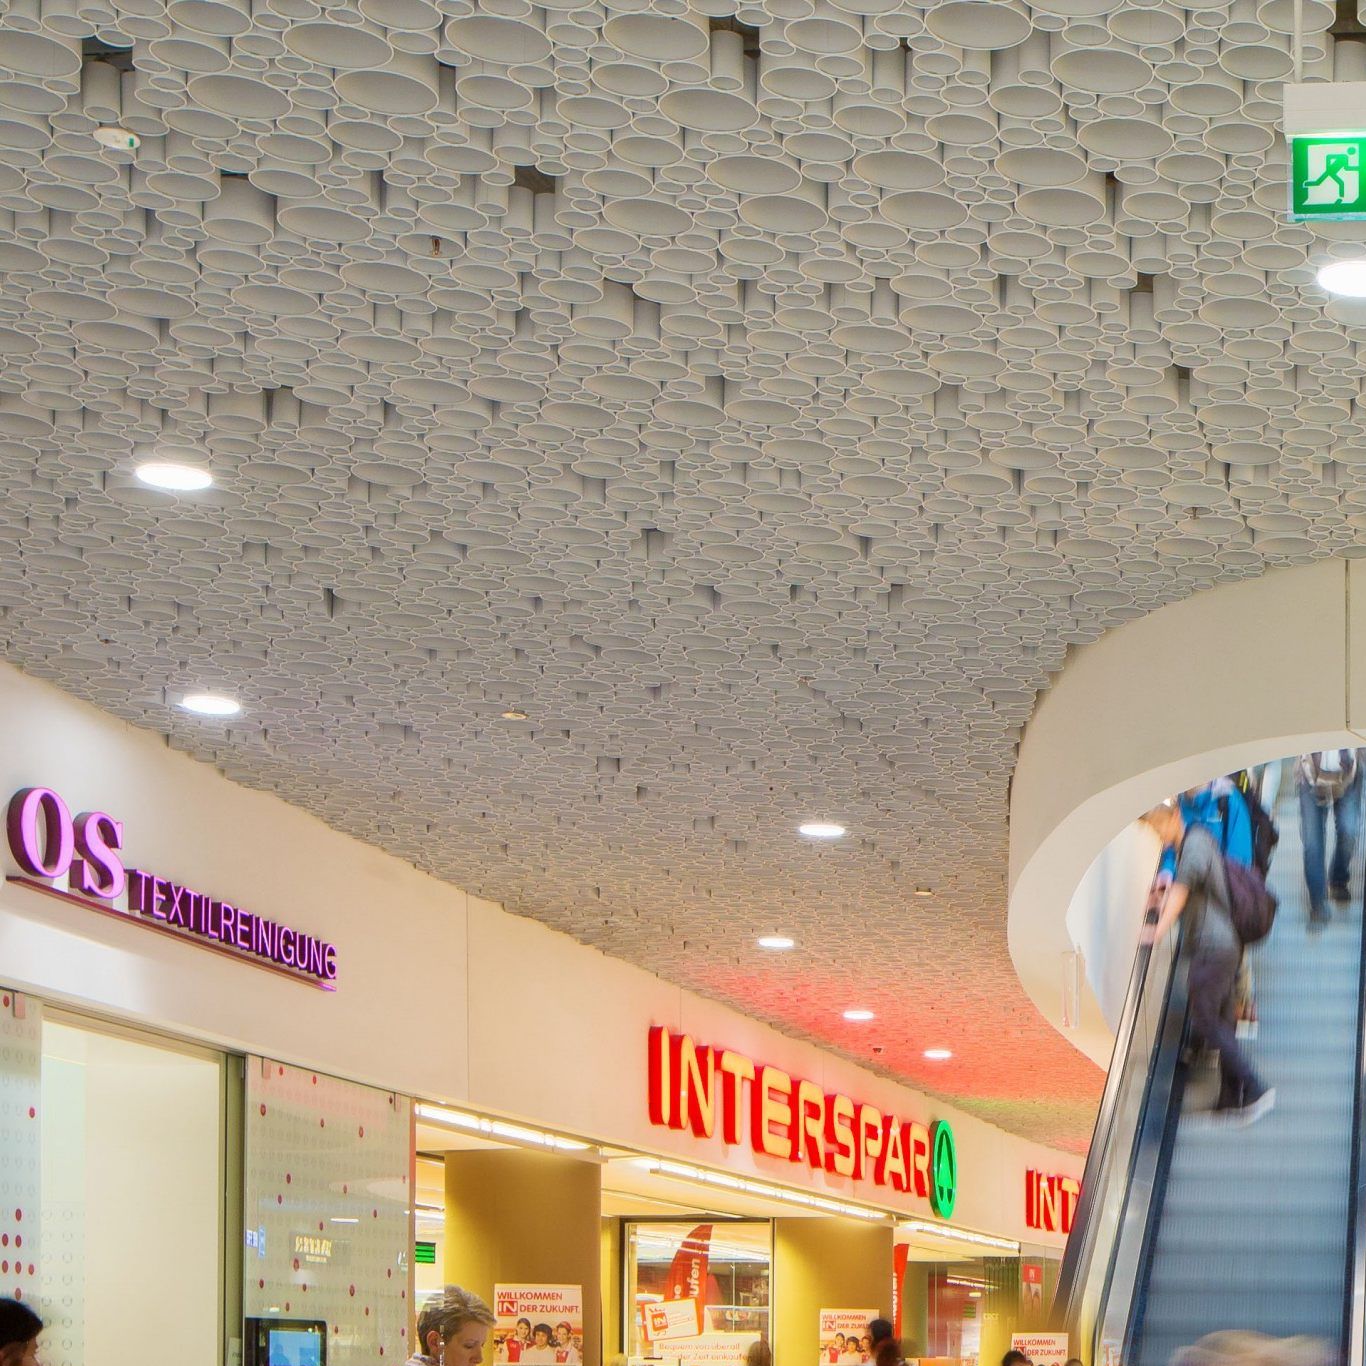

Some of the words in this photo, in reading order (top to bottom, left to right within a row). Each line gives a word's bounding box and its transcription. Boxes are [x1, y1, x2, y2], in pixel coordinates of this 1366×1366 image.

[7, 788, 125, 899] OS
[126, 869, 337, 980] TEXTILREINIGUNG
[649, 1026, 930, 1198] INTERSPAR
[497, 1292, 563, 1300] WILLKOMMEN
[498, 1302, 517, 1314] IN
[520, 1305, 538, 1313] DER
